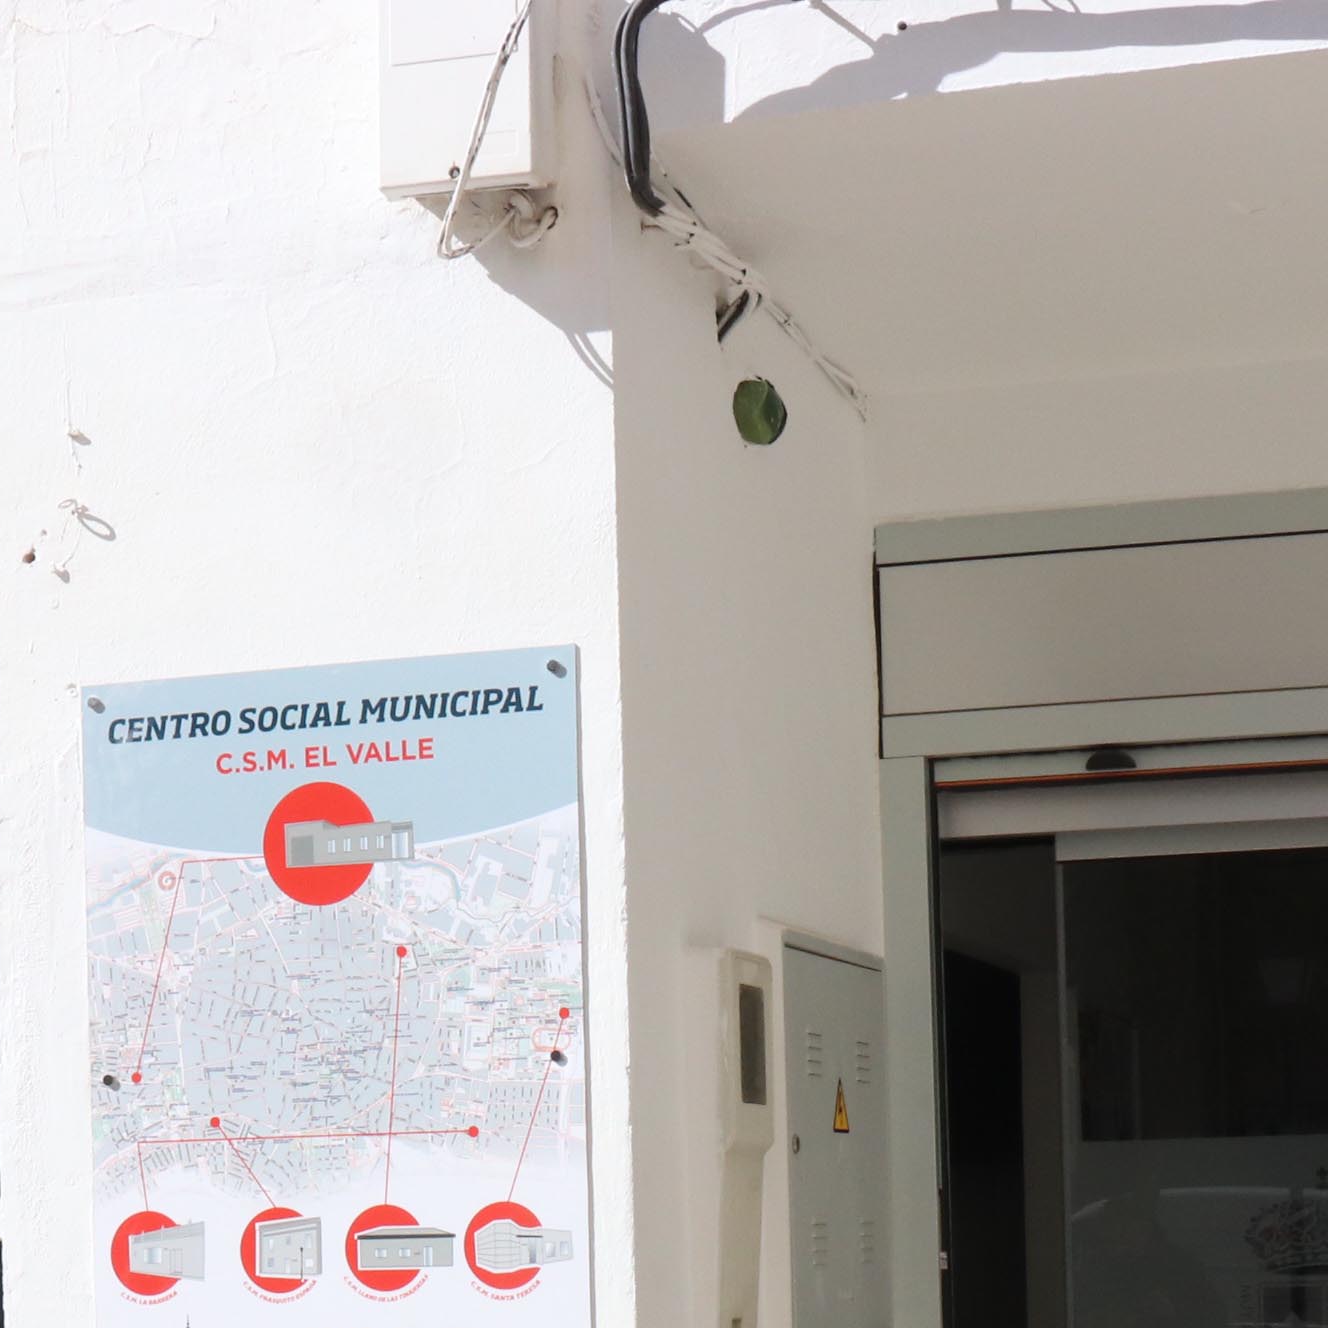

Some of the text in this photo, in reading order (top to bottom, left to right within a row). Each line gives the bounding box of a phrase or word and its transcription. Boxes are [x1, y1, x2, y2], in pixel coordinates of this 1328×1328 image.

[108, 685, 544, 744] CENTRO SOCIAL MUNICIPAL
[216, 737, 434, 774] C.S.M. EL VALLE
